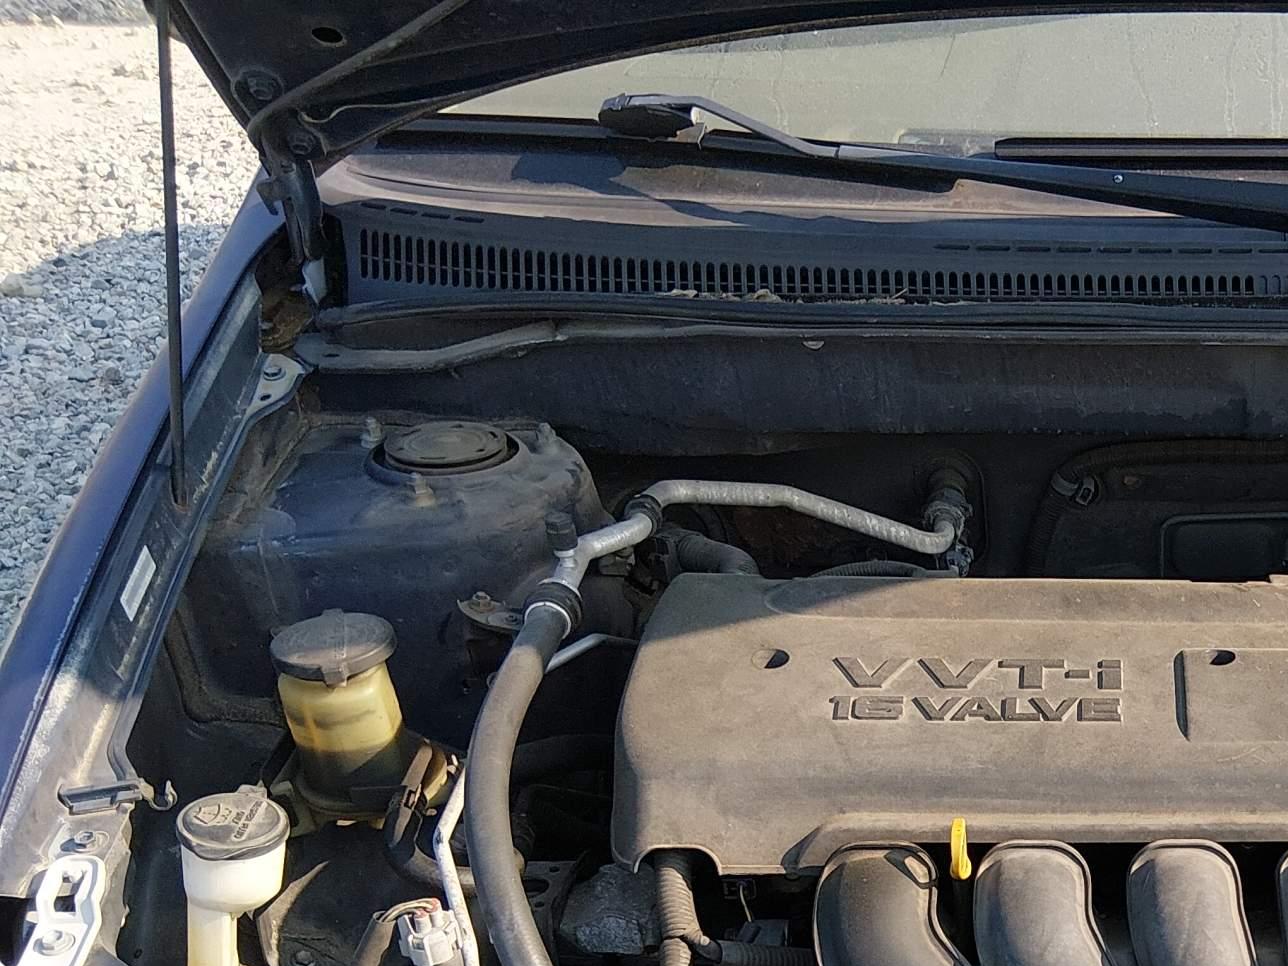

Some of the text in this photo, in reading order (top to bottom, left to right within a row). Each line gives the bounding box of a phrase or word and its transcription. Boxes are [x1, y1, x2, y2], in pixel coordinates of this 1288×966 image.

[832, 656, 1123, 690] VVT-i
[829, 695, 1122, 722] 16 VALVE
